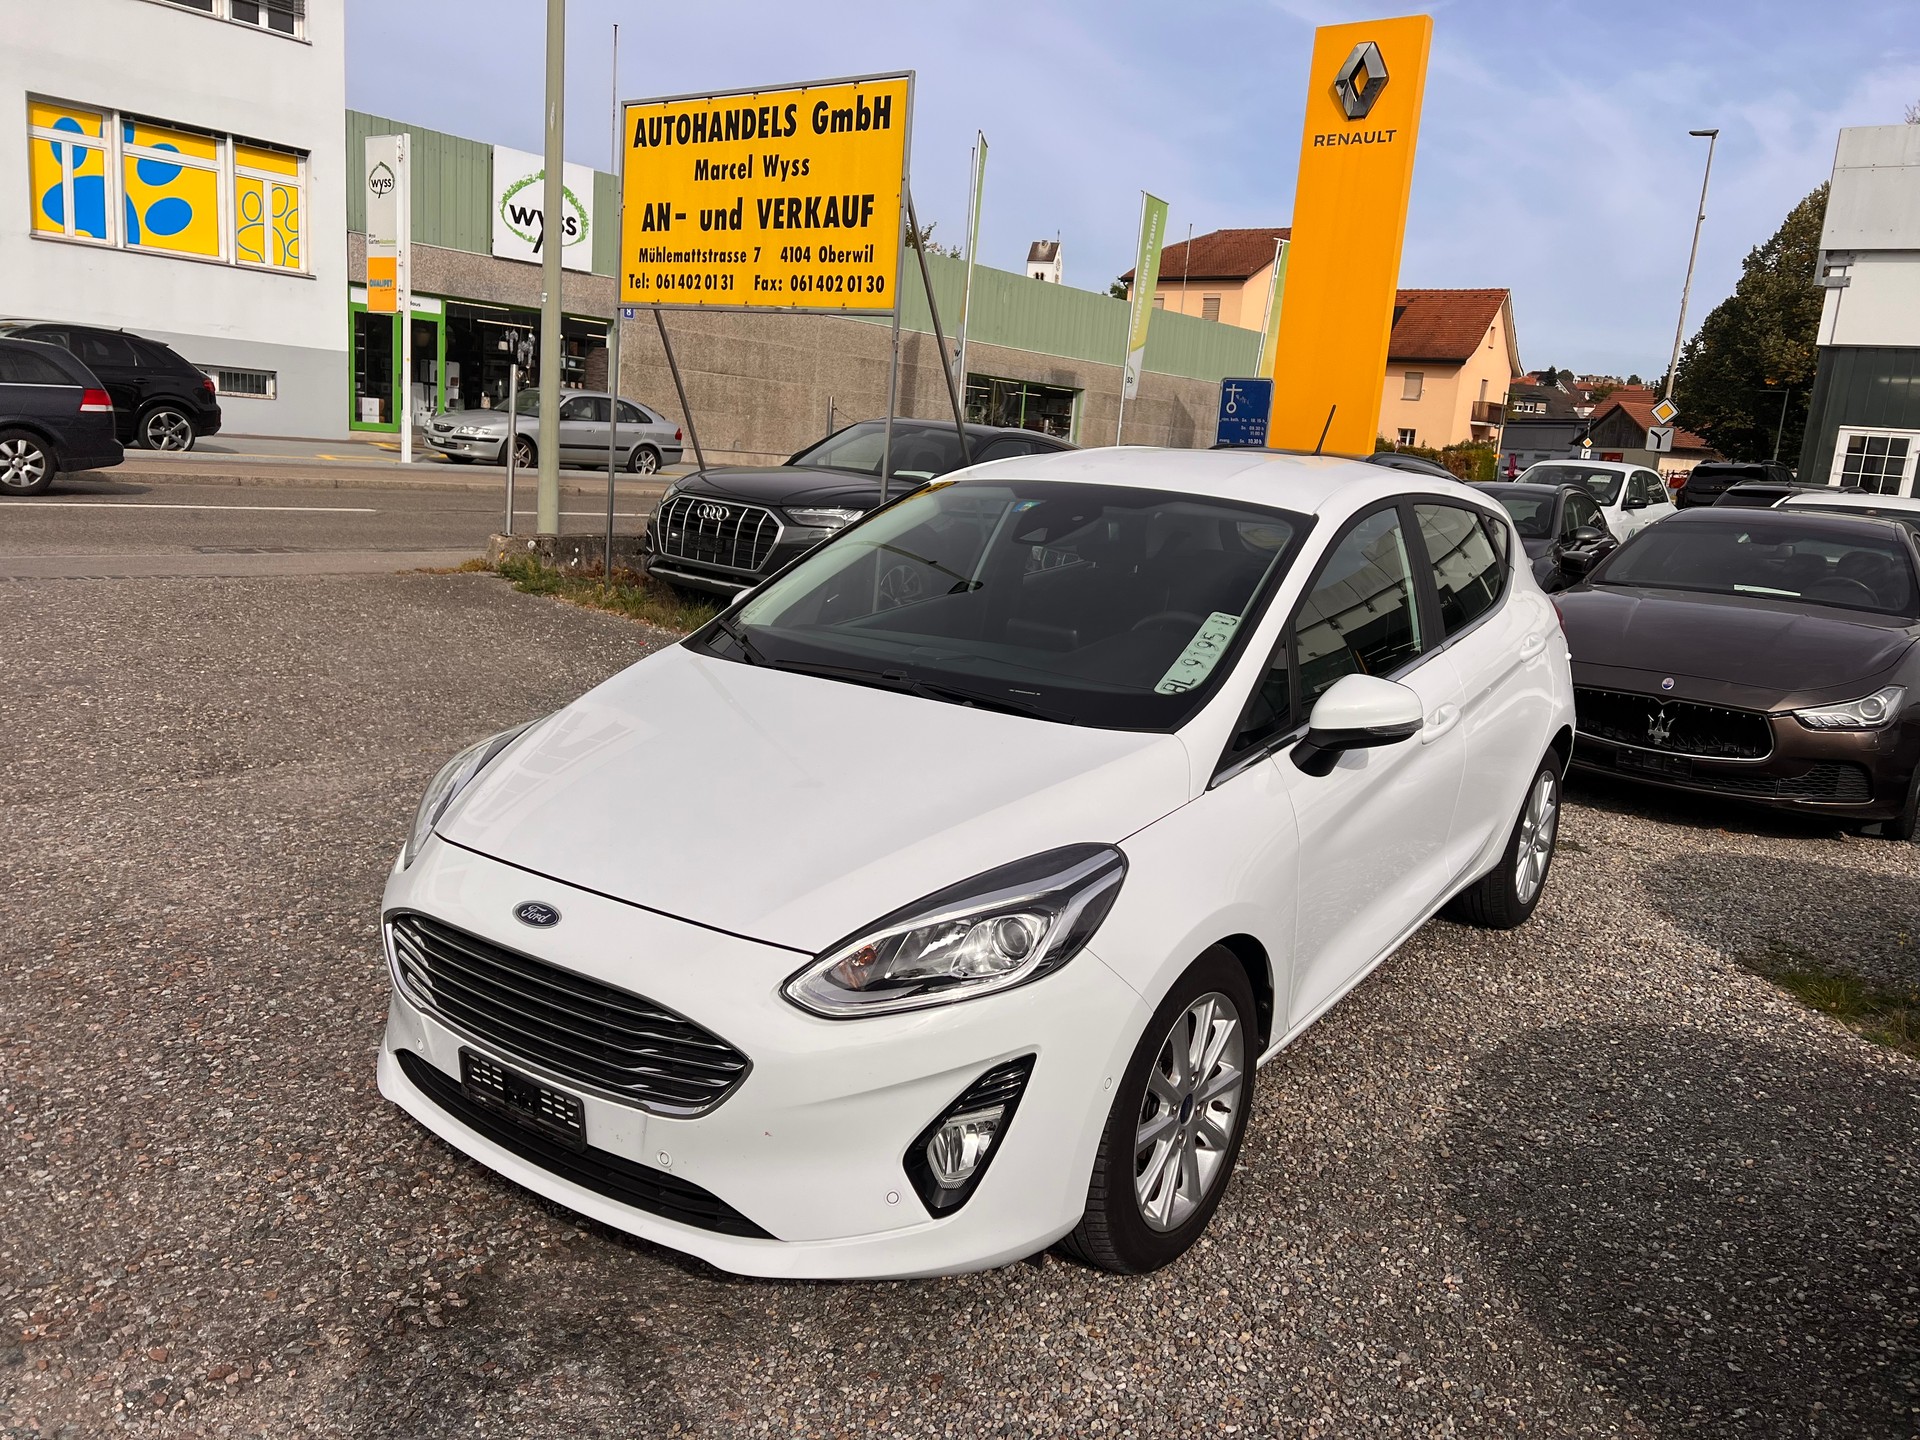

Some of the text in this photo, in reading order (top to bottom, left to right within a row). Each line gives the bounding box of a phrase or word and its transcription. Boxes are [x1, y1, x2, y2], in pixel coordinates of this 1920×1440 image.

[633, 95, 892, 148] AUTOHANDELS GmbH
[1314, 130, 1397, 147] RENAULT
[694, 154, 810, 182] Marcel Wyss
[371, 178, 392, 198] wyss
[700, 197, 743, 232] und
[757, 194, 875, 229] VERKAUF
[509, 204, 577, 254] wys
[639, 244, 874, 263] Mühlemattstrasse 7 4104 Oberwil
[629, 272, 650, 289] Tel:
[754, 274, 782, 291] Fax:
[1140, 254, 1151, 294] deinen
[521, 905, 552, 923] Ford
